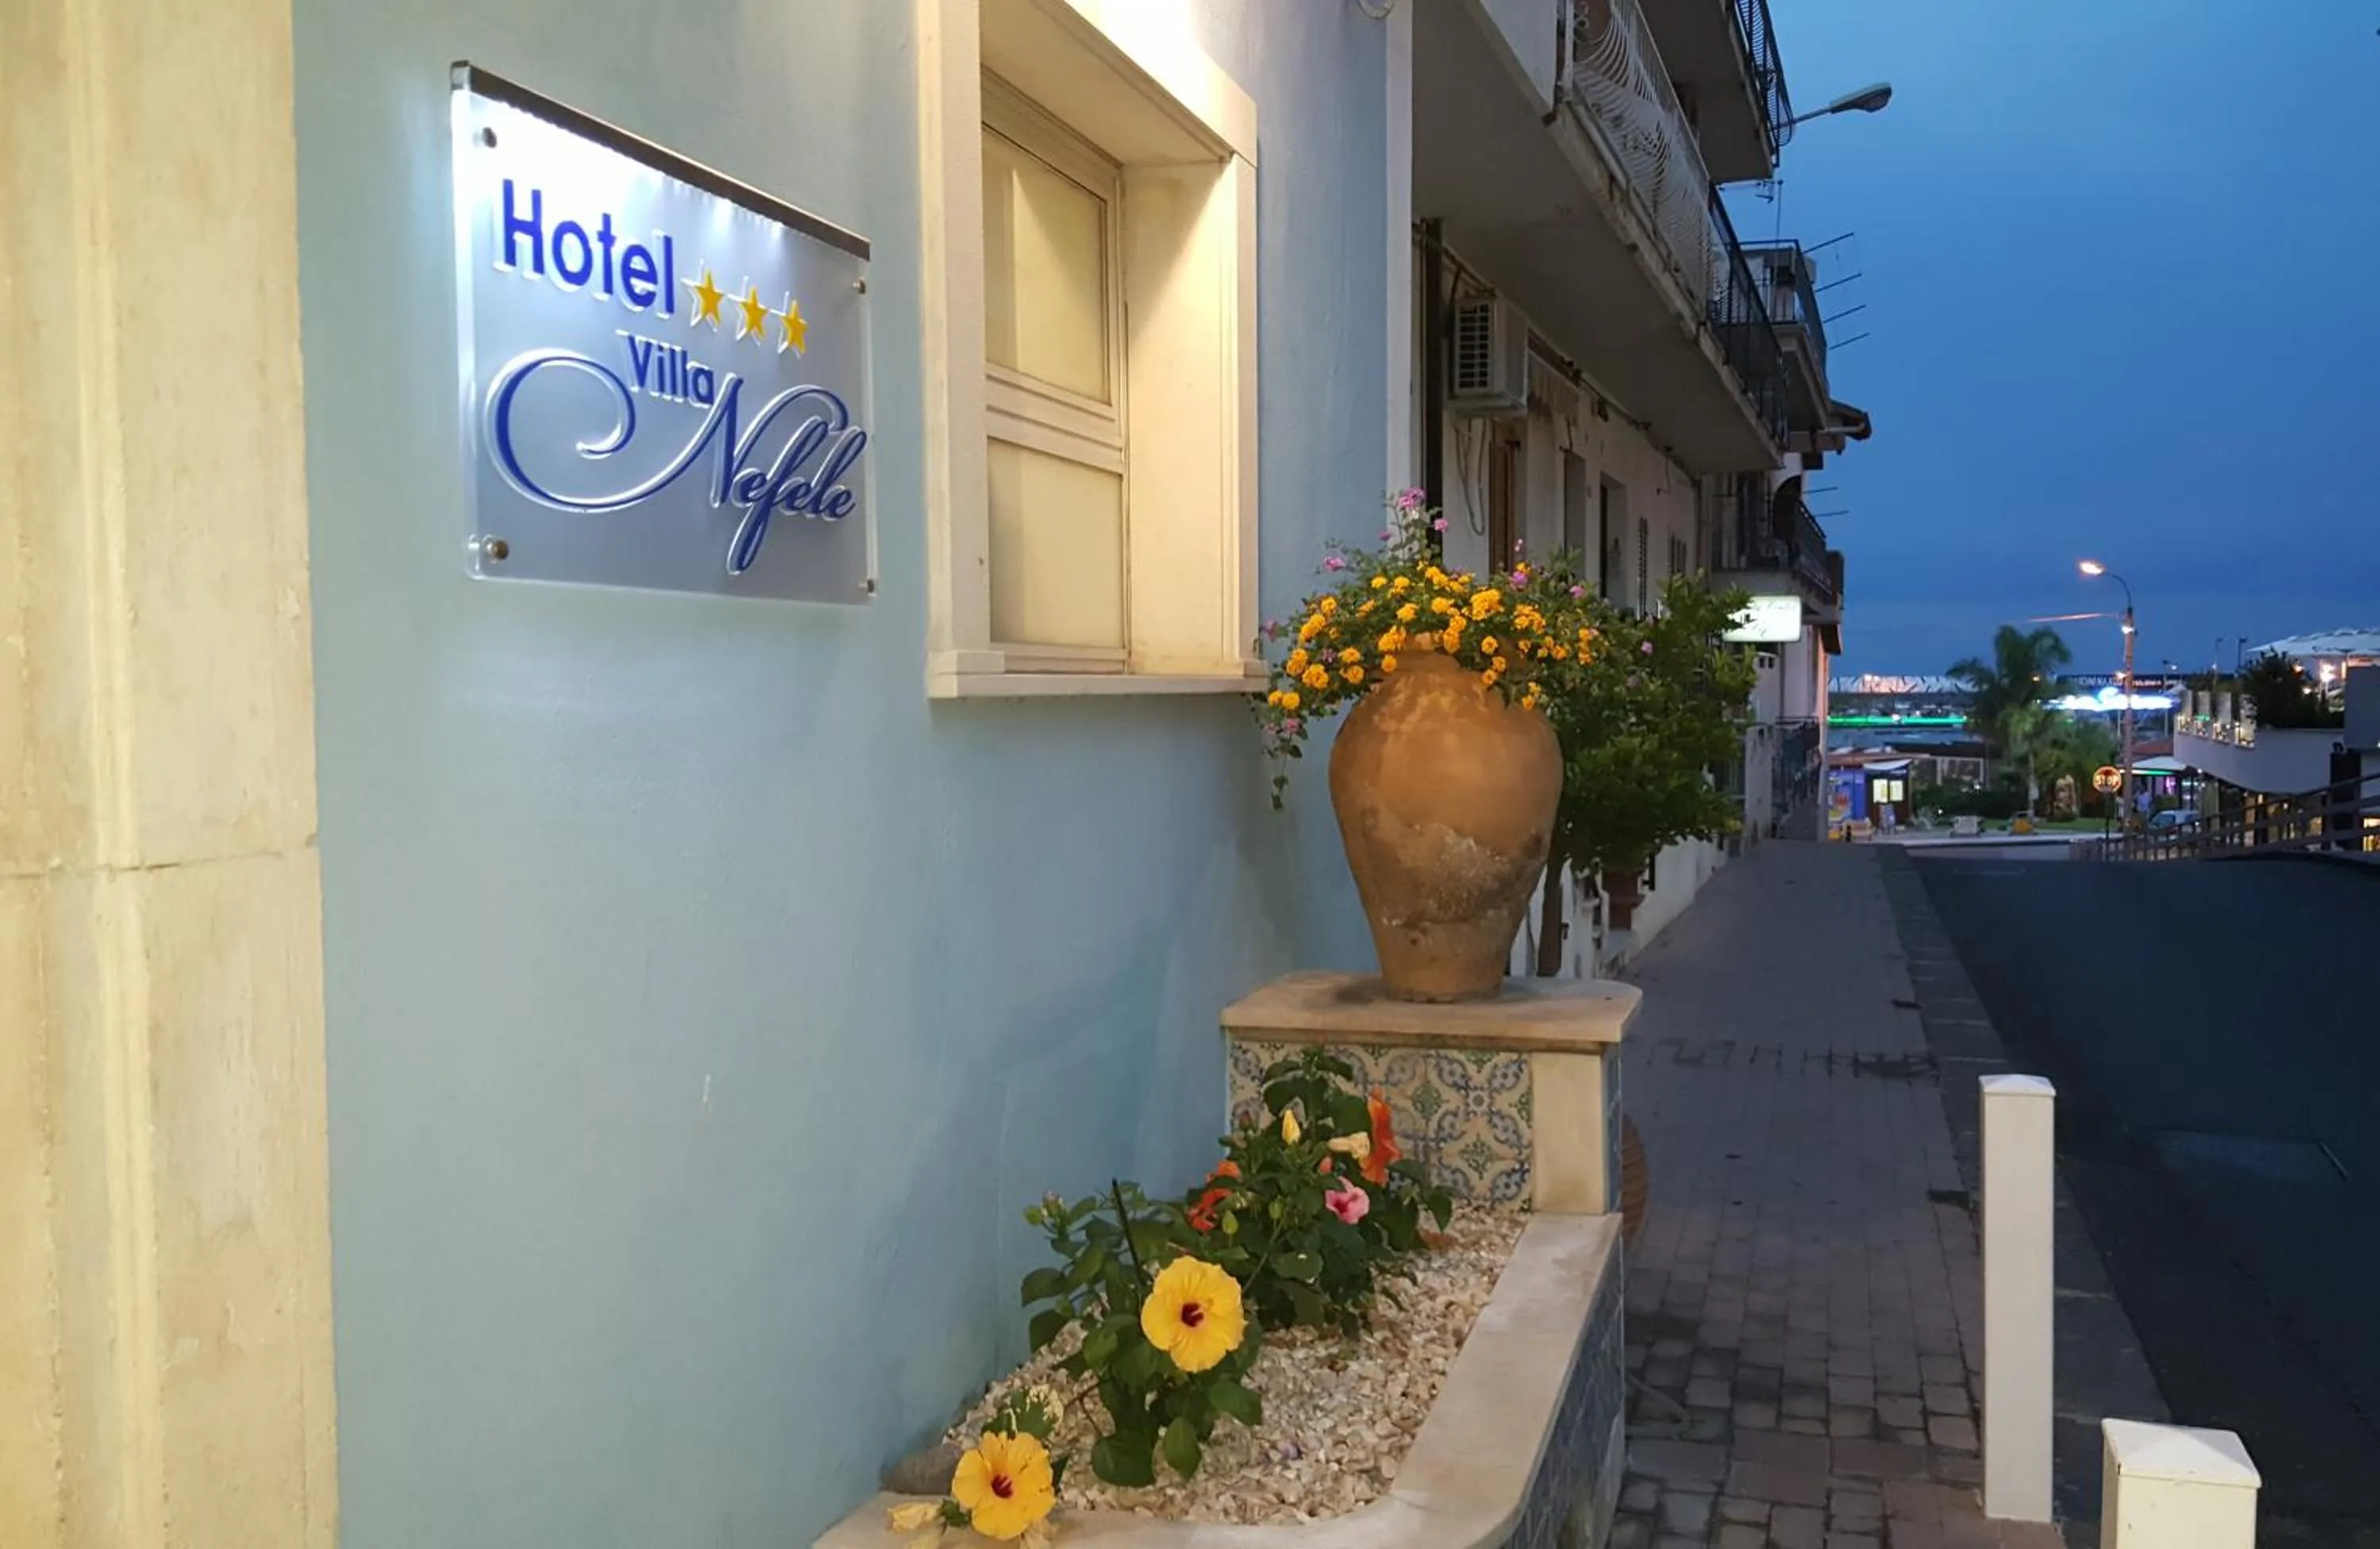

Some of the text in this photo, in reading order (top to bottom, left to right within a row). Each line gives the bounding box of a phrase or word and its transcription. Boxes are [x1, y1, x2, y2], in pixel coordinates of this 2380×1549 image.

[502, 179, 674, 314] Hotel
[627, 334, 715, 406] Villa
[489, 352, 868, 572] Nefele
[2094, 774, 2119, 786] STOP
